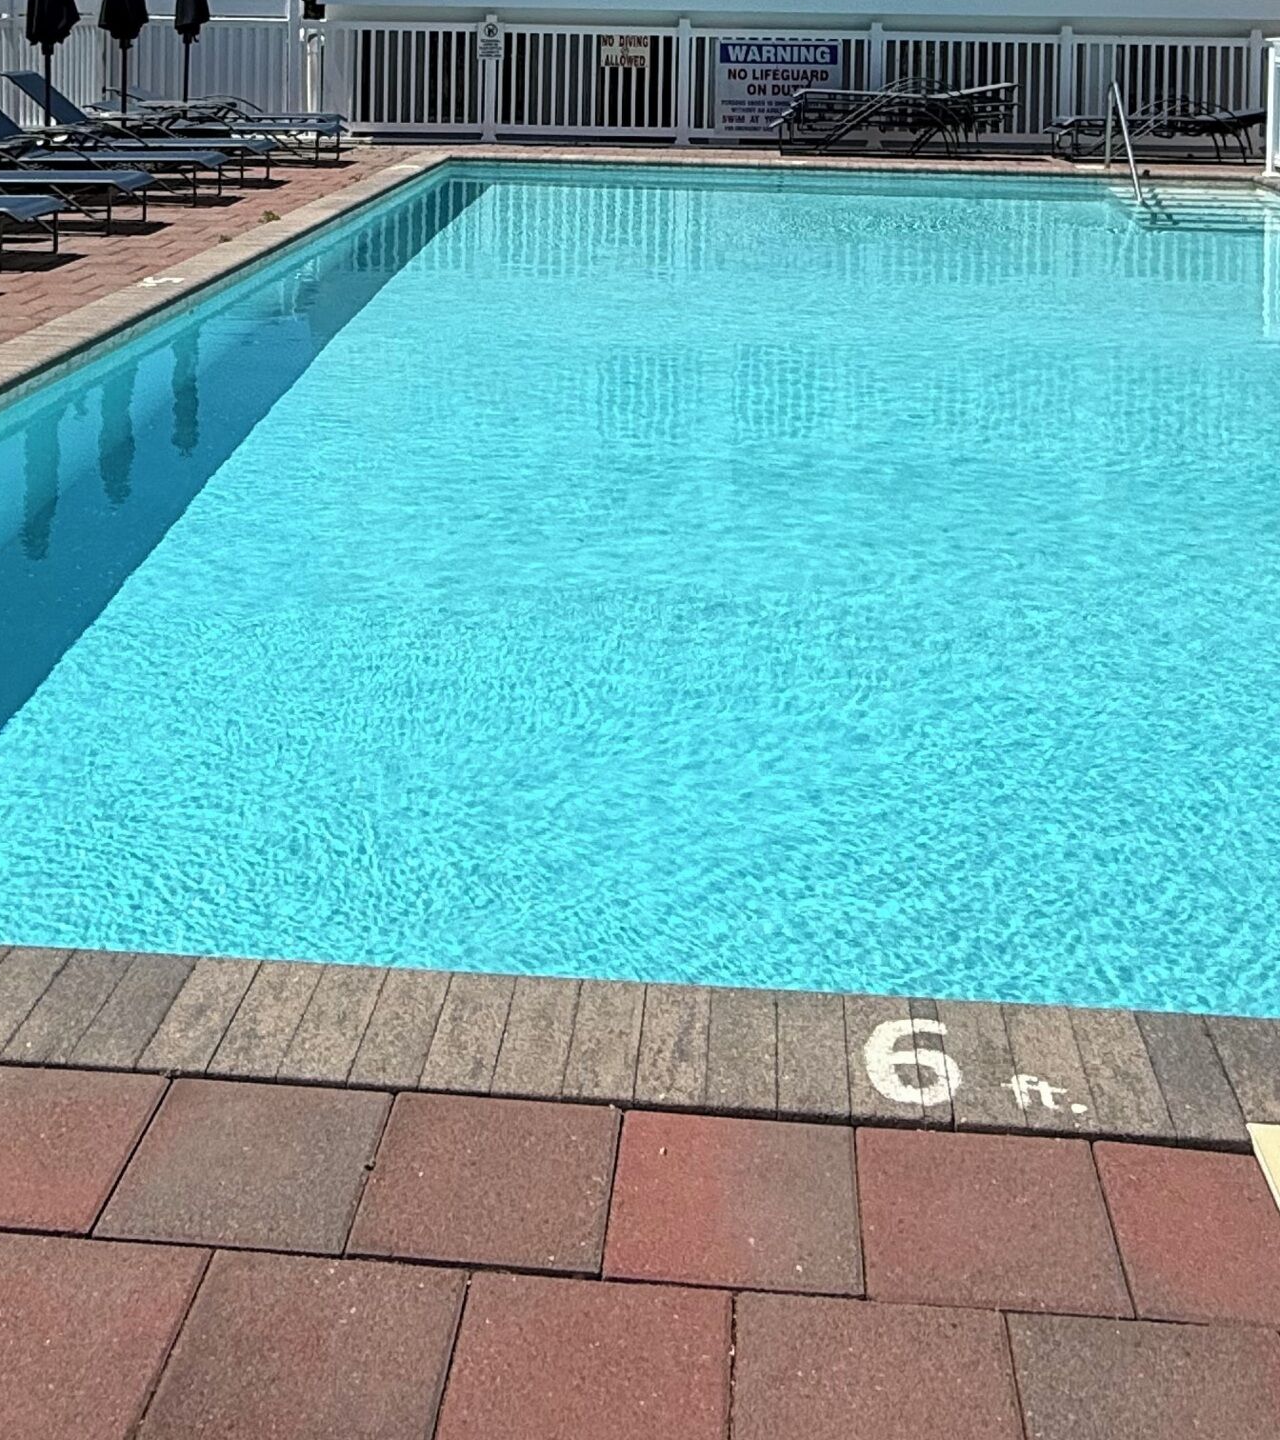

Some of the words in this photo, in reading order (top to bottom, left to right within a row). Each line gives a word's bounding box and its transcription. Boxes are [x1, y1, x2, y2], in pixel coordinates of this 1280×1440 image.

[602, 34, 614, 47] NO
[619, 35, 648, 48] DIVING
[605, 54, 646, 66] ALLOWED
[727, 45, 831, 63] WARNING
[727, 68, 747, 80] NO
[752, 69, 829, 81] LIFEGUARD
[747, 84, 766, 96] ON
[862, 1017, 963, 1107] 6
[1001, 1074, 1090, 1115] ft.
